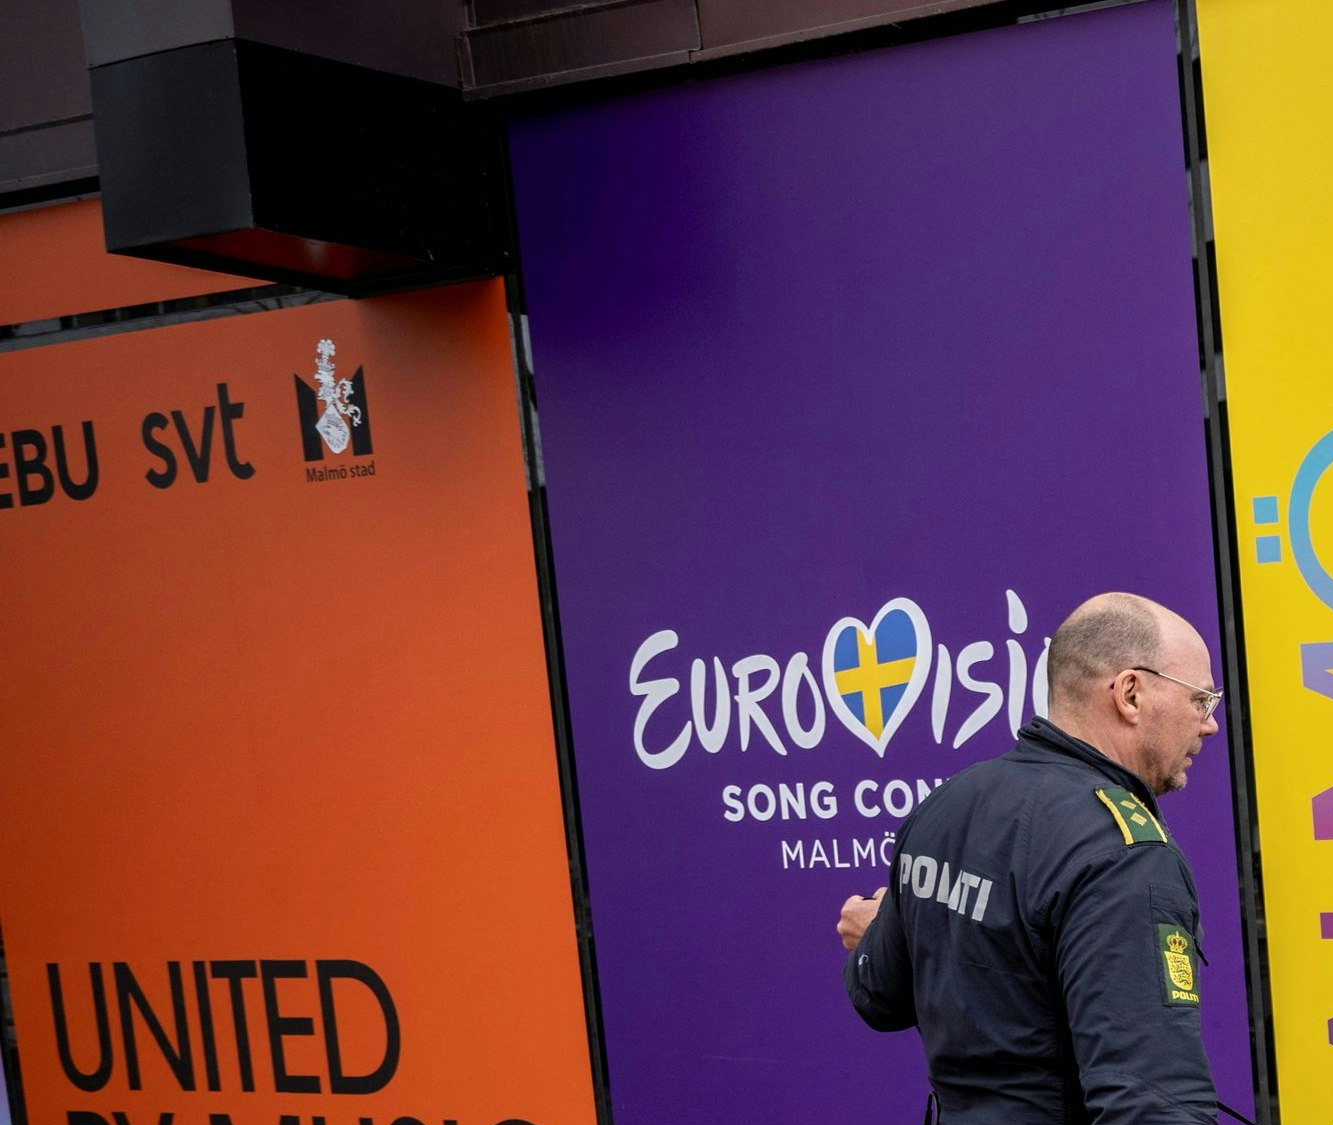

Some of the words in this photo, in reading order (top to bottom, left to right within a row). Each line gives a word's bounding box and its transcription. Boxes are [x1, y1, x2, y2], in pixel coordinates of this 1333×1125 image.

[0, 420, 99, 510] BU
[305, 464, 347, 483] Malmö
[349, 460, 376, 478] stad
[722, 781, 838, 822] SONG
[46, 959, 401, 1095] UNITED
